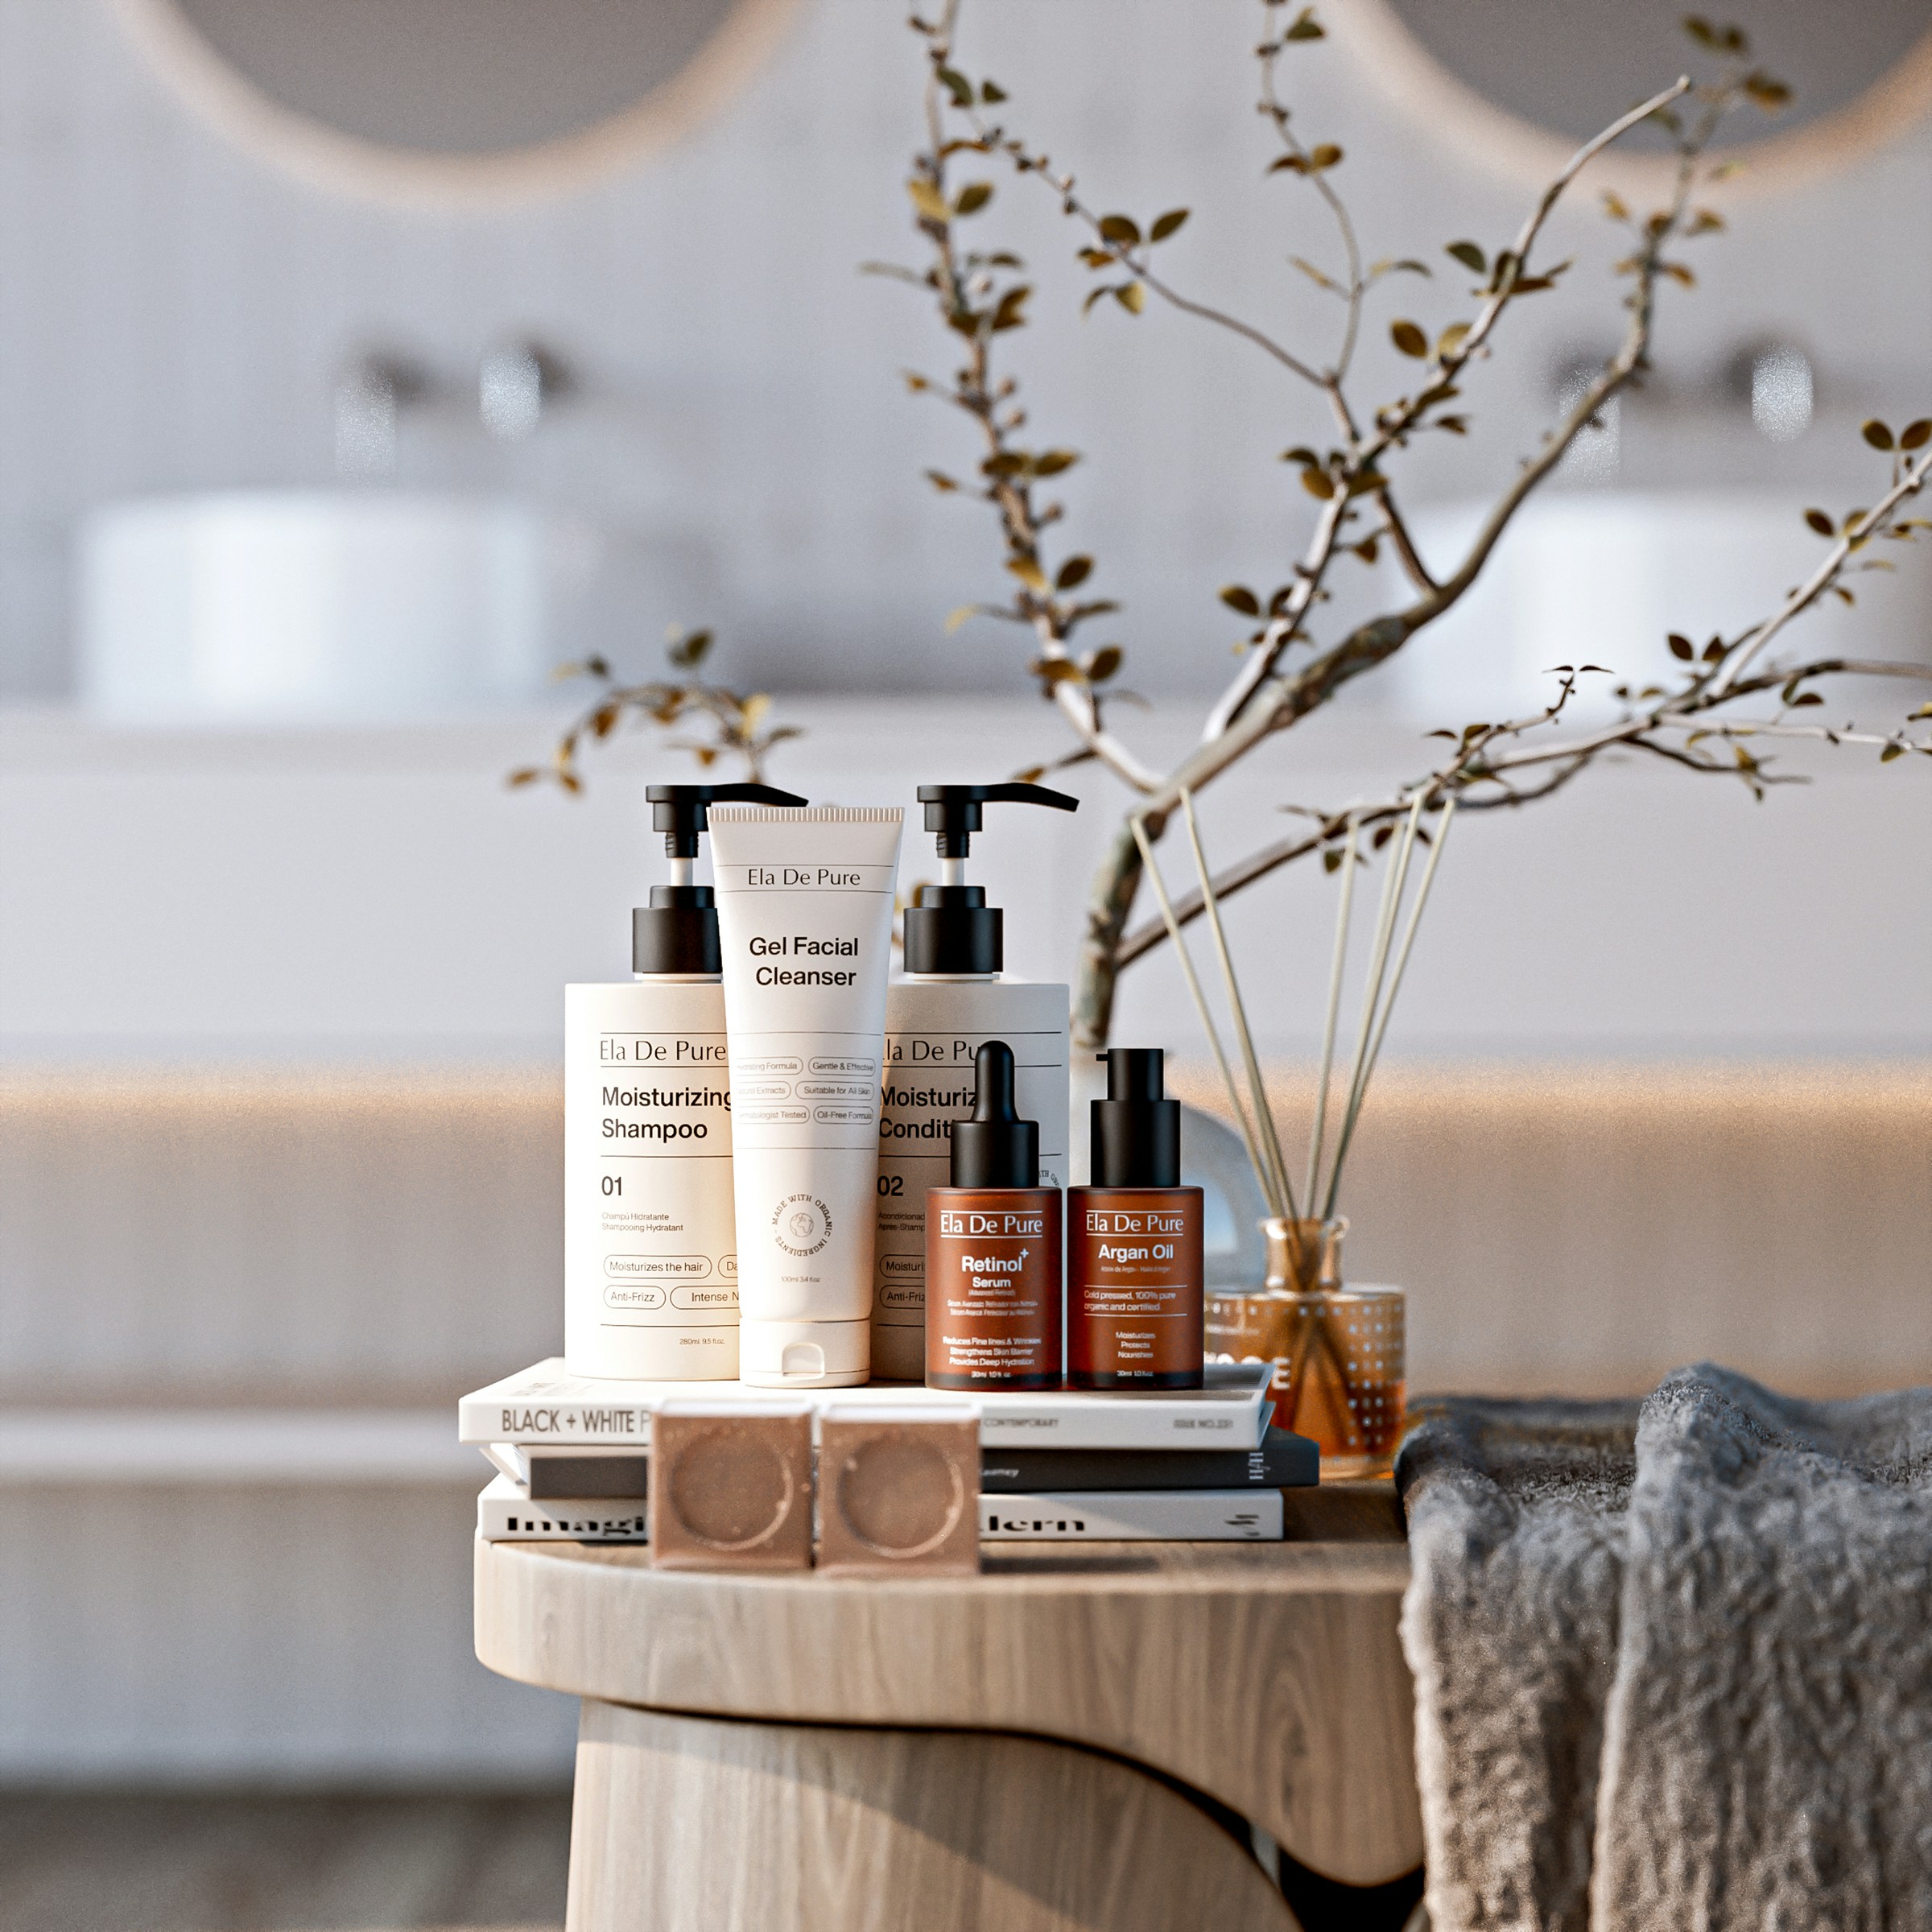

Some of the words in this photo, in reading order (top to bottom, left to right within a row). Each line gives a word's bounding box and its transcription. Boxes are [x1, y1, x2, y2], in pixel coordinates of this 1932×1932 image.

[748, 869, 774, 885] Ela
[783, 869, 811, 886] De
[818, 869, 861, 886] Pure
[749, 937, 786, 956] Gel
[794, 937, 858, 956] Facial
[756, 967, 857, 985] Cleanser
[601, 1038, 625, 1060] Ela
[636, 1041, 667, 1060] De
[676, 1041, 727, 1060] Pure
[883, 1038, 902, 1060] la
[913, 1041, 944, 1060] De
[847, 1063, 873, 1071] Effective
[602, 1118, 708, 1143] Shampoo
[880, 1118, 955, 1138] Condit
[601, 1176, 622, 1196] 01
[877, 1175, 903, 1196] 02
[788, 1194, 812, 1203] WITH
[631, 1212, 669, 1220] Hidratante
[772, 1200, 787, 1225] MADE
[815, 1199, 832, 1236] ORGANIC
[602, 1223, 644, 1232] Shampooing
[646, 1224, 683, 1232] Hydratant
[940, 1213, 964, 1233] Ela
[970, 1215, 998, 1233] De
[1005, 1215, 1042, 1233] Pure
[1086, 1213, 1108, 1232] Ela
[1114, 1215, 1141, 1232] De
[1147, 1215, 1183, 1232] Pure
[775, 1236, 828, 1256] INGREDIENTS
[1098, 1244, 1149, 1263] Argan
[1152, 1244, 1174, 1259] Oil
[609, 1261, 663, 1272] Moisturizes
[666, 1261, 682, 1272] the
[684, 1261, 704, 1272] hair
[886, 1261, 925, 1272] Moisturi
[972, 1276, 1012, 1288] Serum
[611, 1291, 655, 1302] Anti-Frizz
[691, 1292, 729, 1302] Intense
[1084, 1290, 1100, 1298] Cold
[1135, 1291, 1158, 1299] 100%
[1159, 1292, 1176, 1300] pure
[1084, 1302, 1109, 1311] organic
[972, 1337, 987, 1345] Fine
[1121, 1340, 1150, 1348] Protects
[950, 1347, 993, 1357] Strengthens
[993, 1348, 1009, 1356] Skin
[949, 1357, 979, 1366] Provides
[979, 1358, 1000, 1367] Deep
[1001, 1358, 1034, 1367] Hydration
[502, 1410, 561, 1432] BLACK
[566, 1414, 576, 1429] +
[582, 1410, 634, 1433] WHITE
